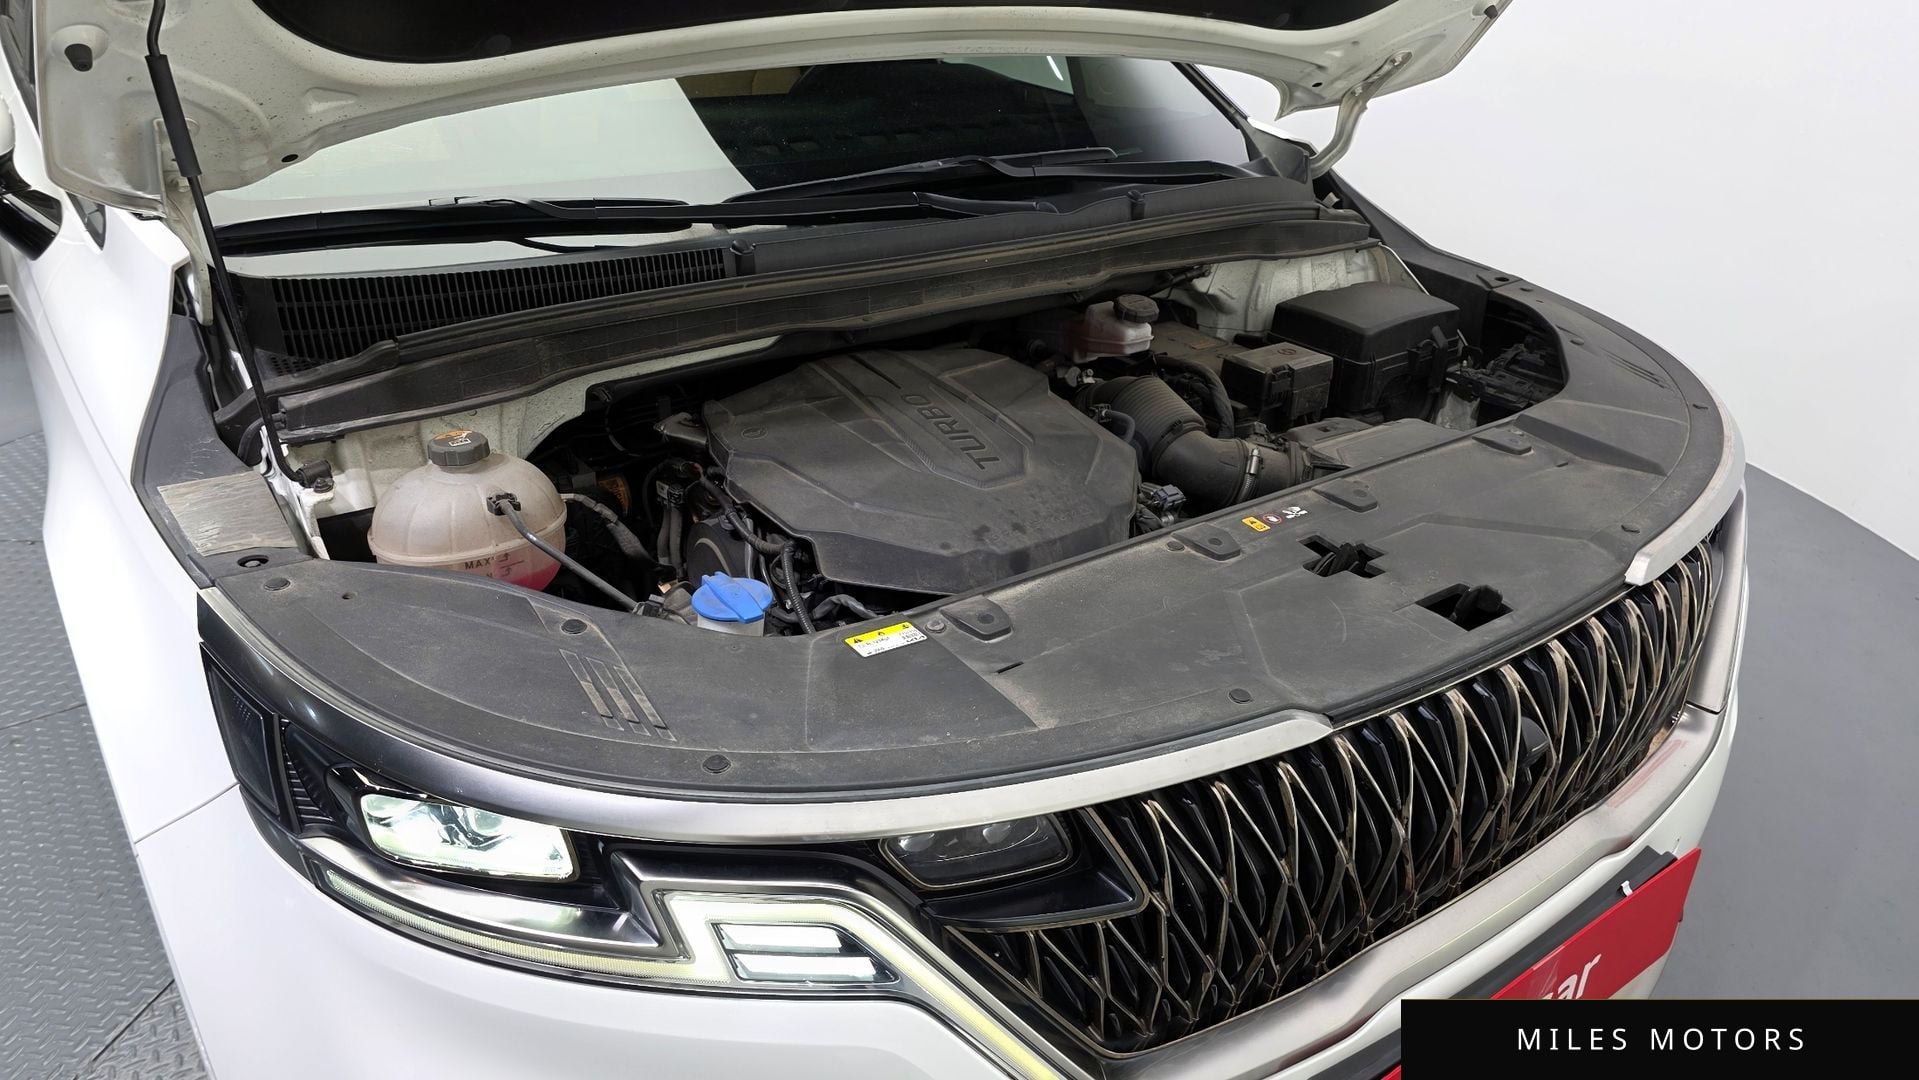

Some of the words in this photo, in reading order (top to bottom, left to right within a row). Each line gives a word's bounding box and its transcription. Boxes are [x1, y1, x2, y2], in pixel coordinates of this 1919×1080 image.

[900, 393, 1001, 471] TURBO
[464, 557, 491, 570] MAX
[1541, 953, 1602, 1000] ar
